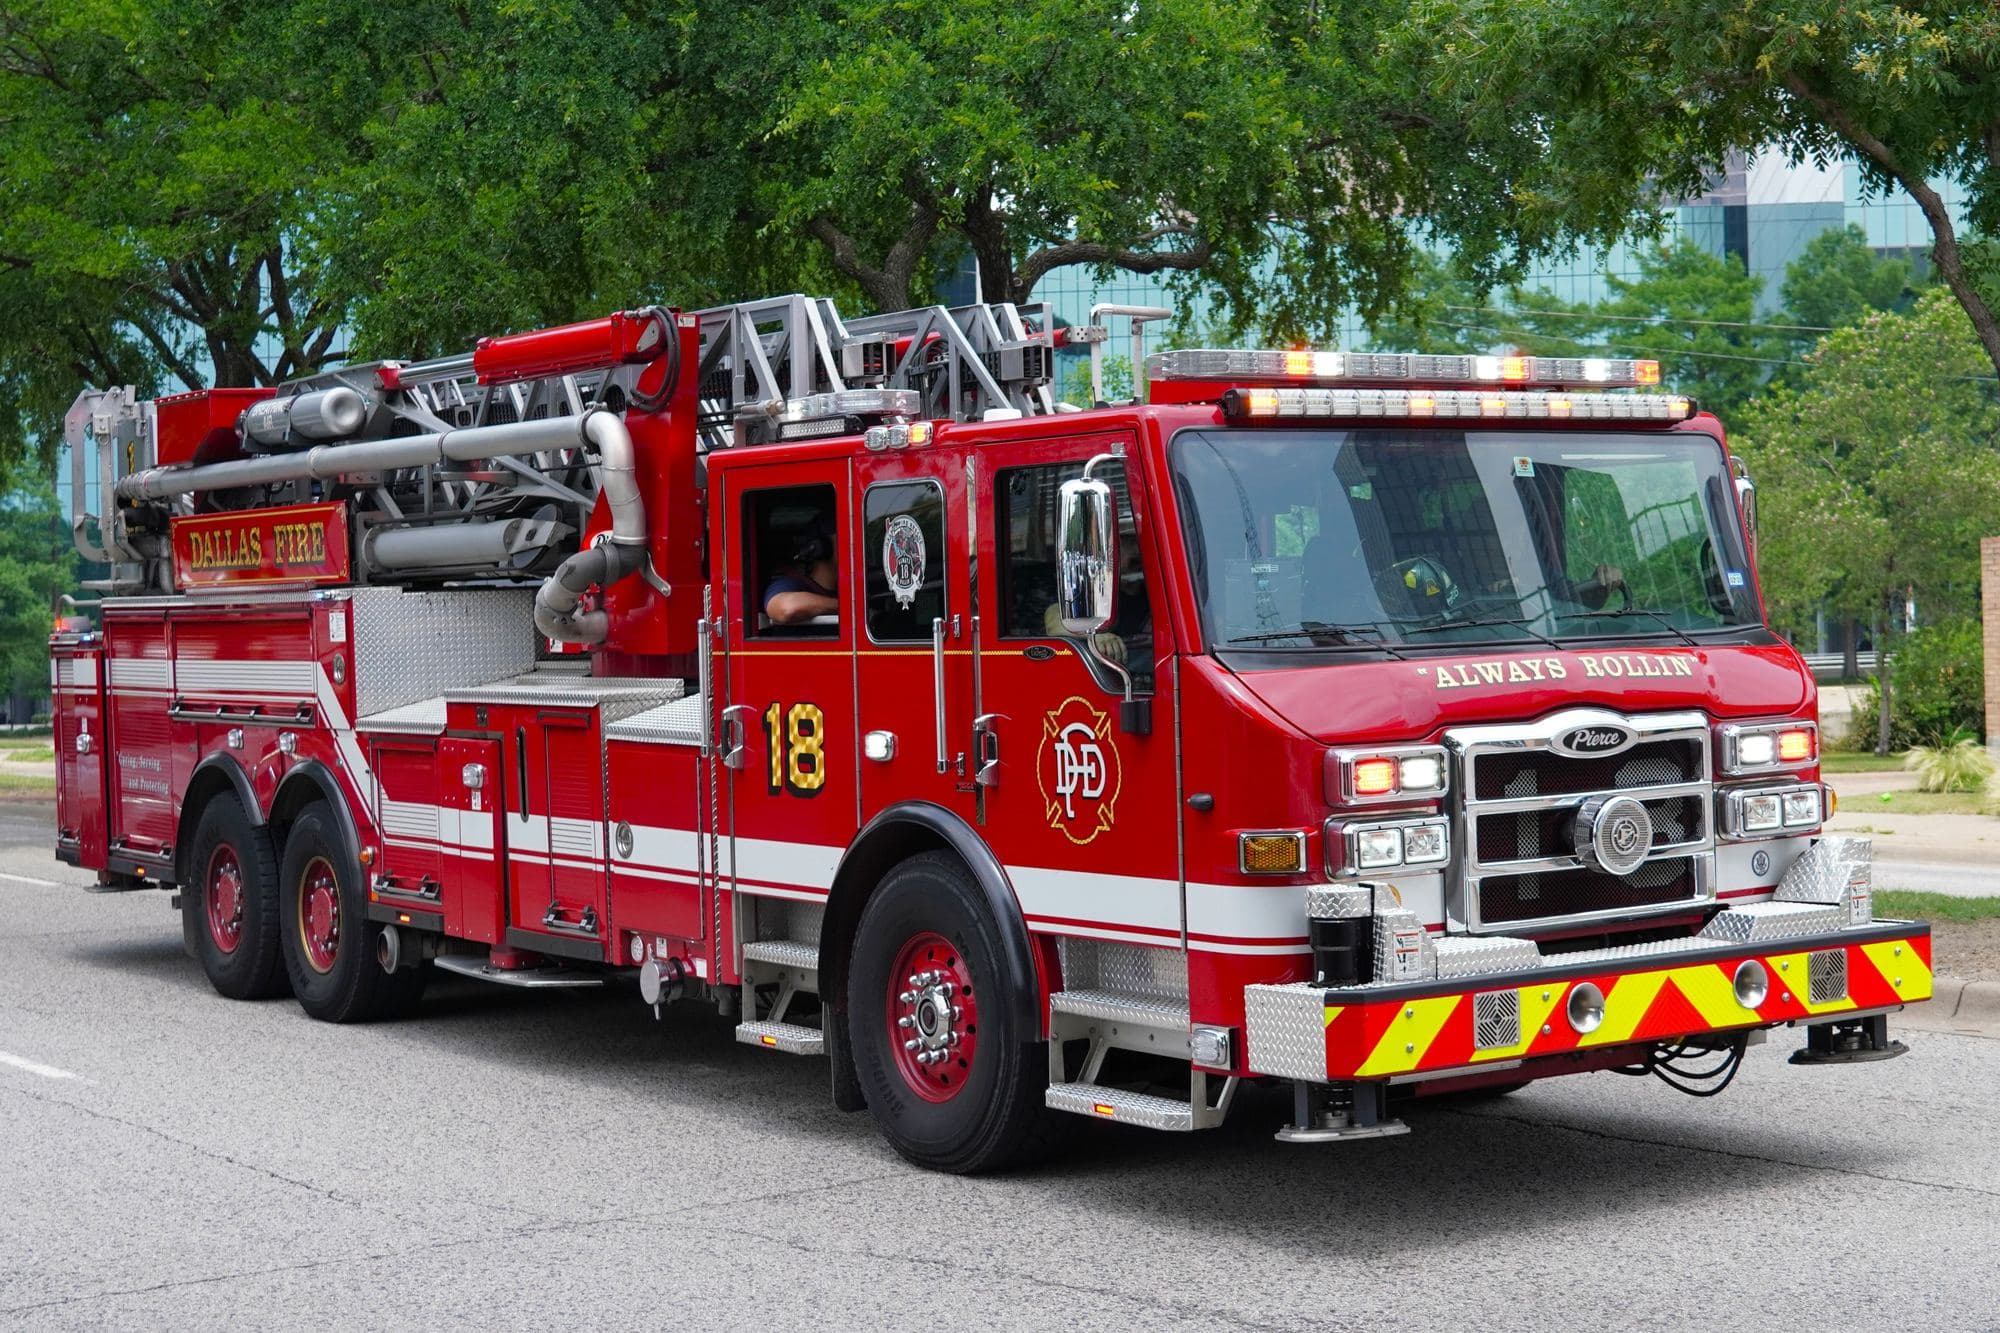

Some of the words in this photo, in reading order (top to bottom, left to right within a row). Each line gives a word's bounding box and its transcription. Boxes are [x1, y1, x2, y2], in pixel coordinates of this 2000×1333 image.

[190, 527, 262, 571] DALLAS
[273, 522, 326, 565] FIRE
[762, 701, 826, 797] 18
[1571, 729, 1620, 751] Pierce
